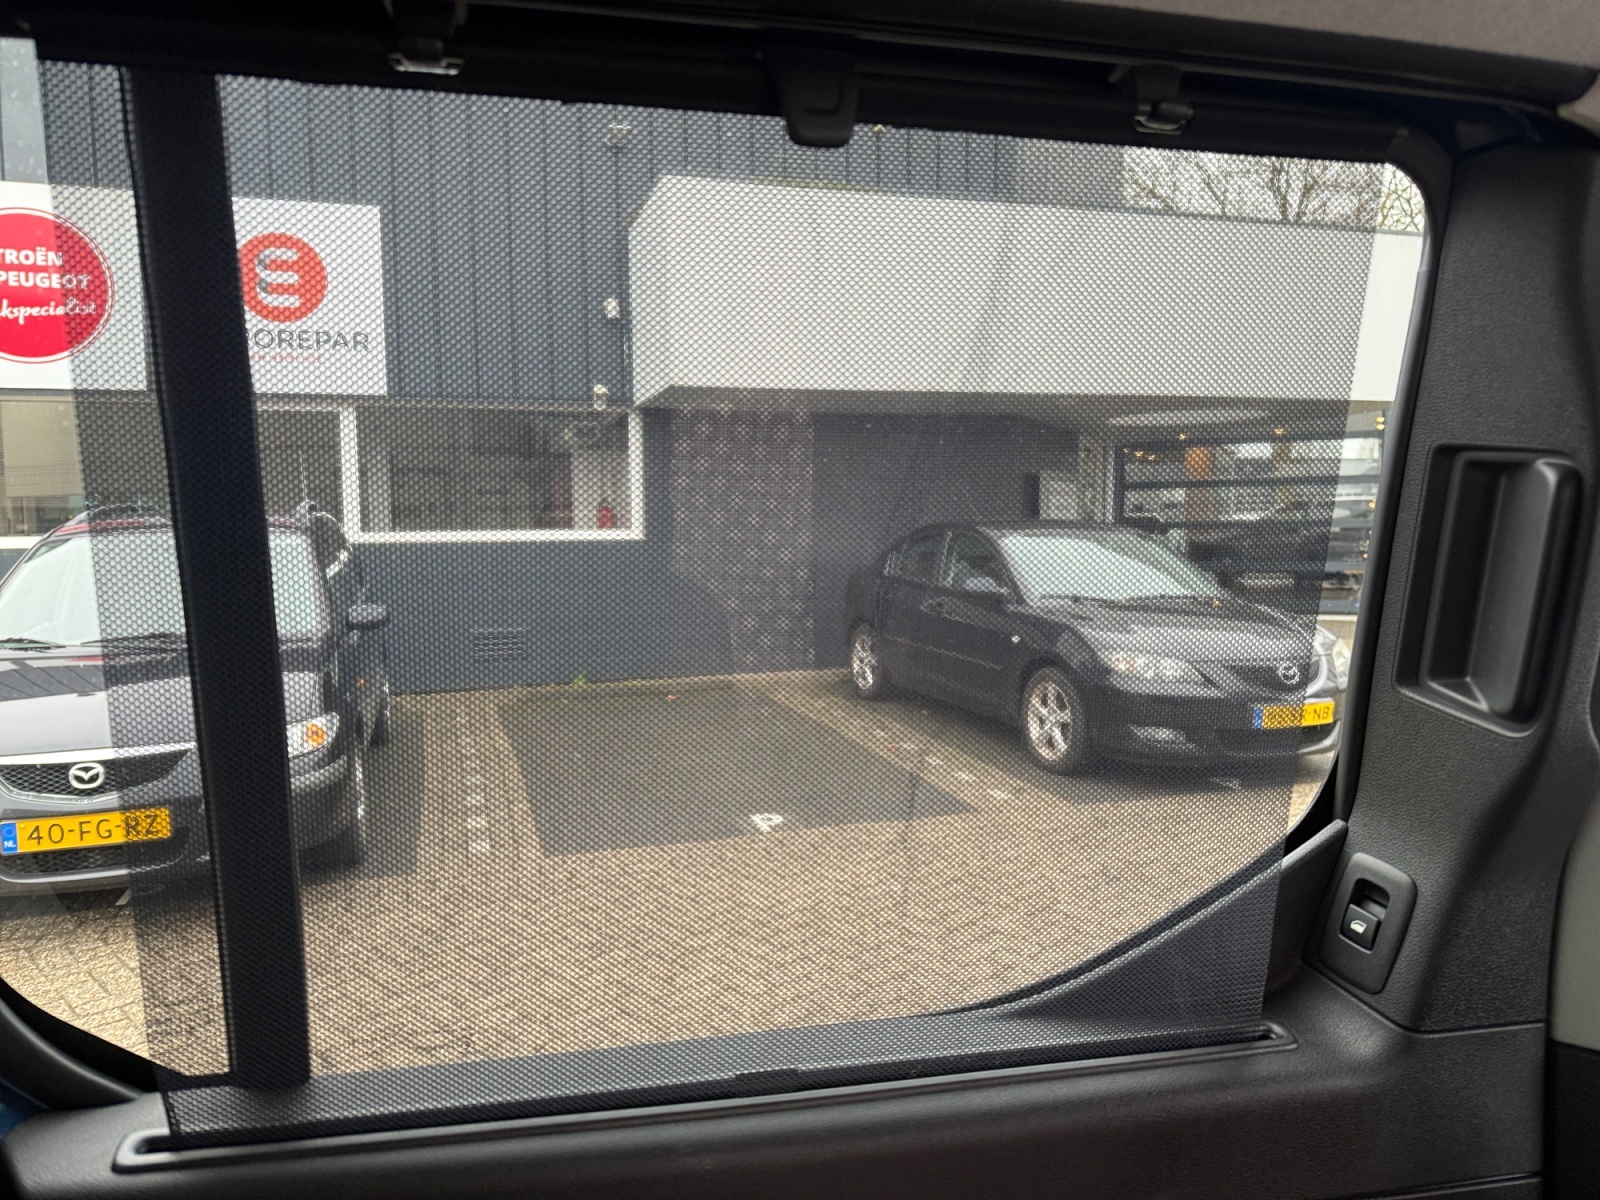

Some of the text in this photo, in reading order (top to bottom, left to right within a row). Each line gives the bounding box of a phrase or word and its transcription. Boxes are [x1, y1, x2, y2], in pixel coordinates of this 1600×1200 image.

[0, 297, 97, 325] kspecialist
[246, 328, 369, 351] OREPAR
[27, 814, 160, 846] 40-FG-RZ
[4, 840, 16, 848] NL
